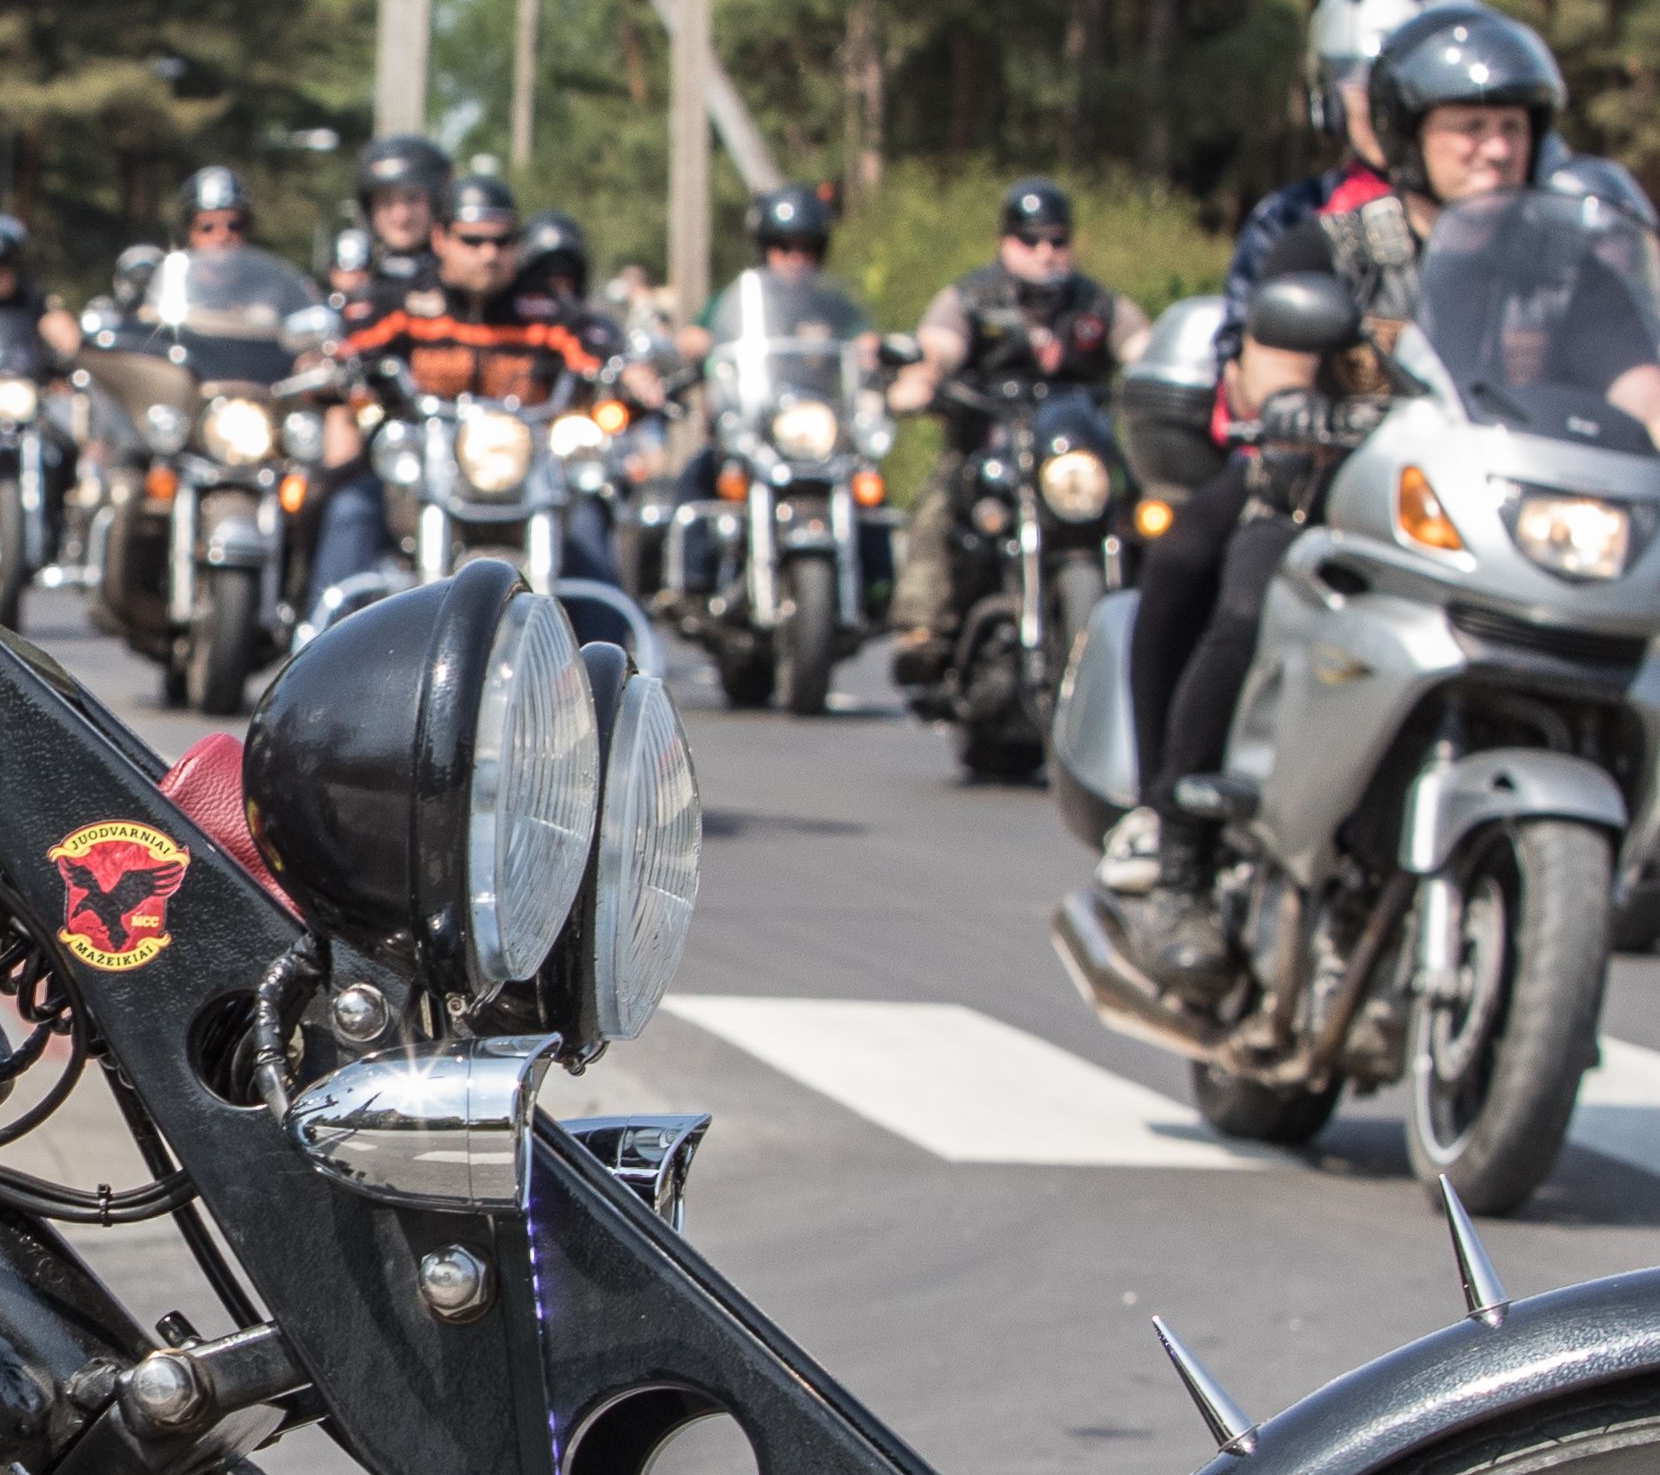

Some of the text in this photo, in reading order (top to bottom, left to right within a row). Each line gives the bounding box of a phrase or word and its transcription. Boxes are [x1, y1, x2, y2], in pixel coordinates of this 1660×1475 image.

[71, 826, 170, 855] JUODVARNIAI
[131, 915, 160, 927] MCC
[76, 943, 154, 966] MAŽEIKIAI
